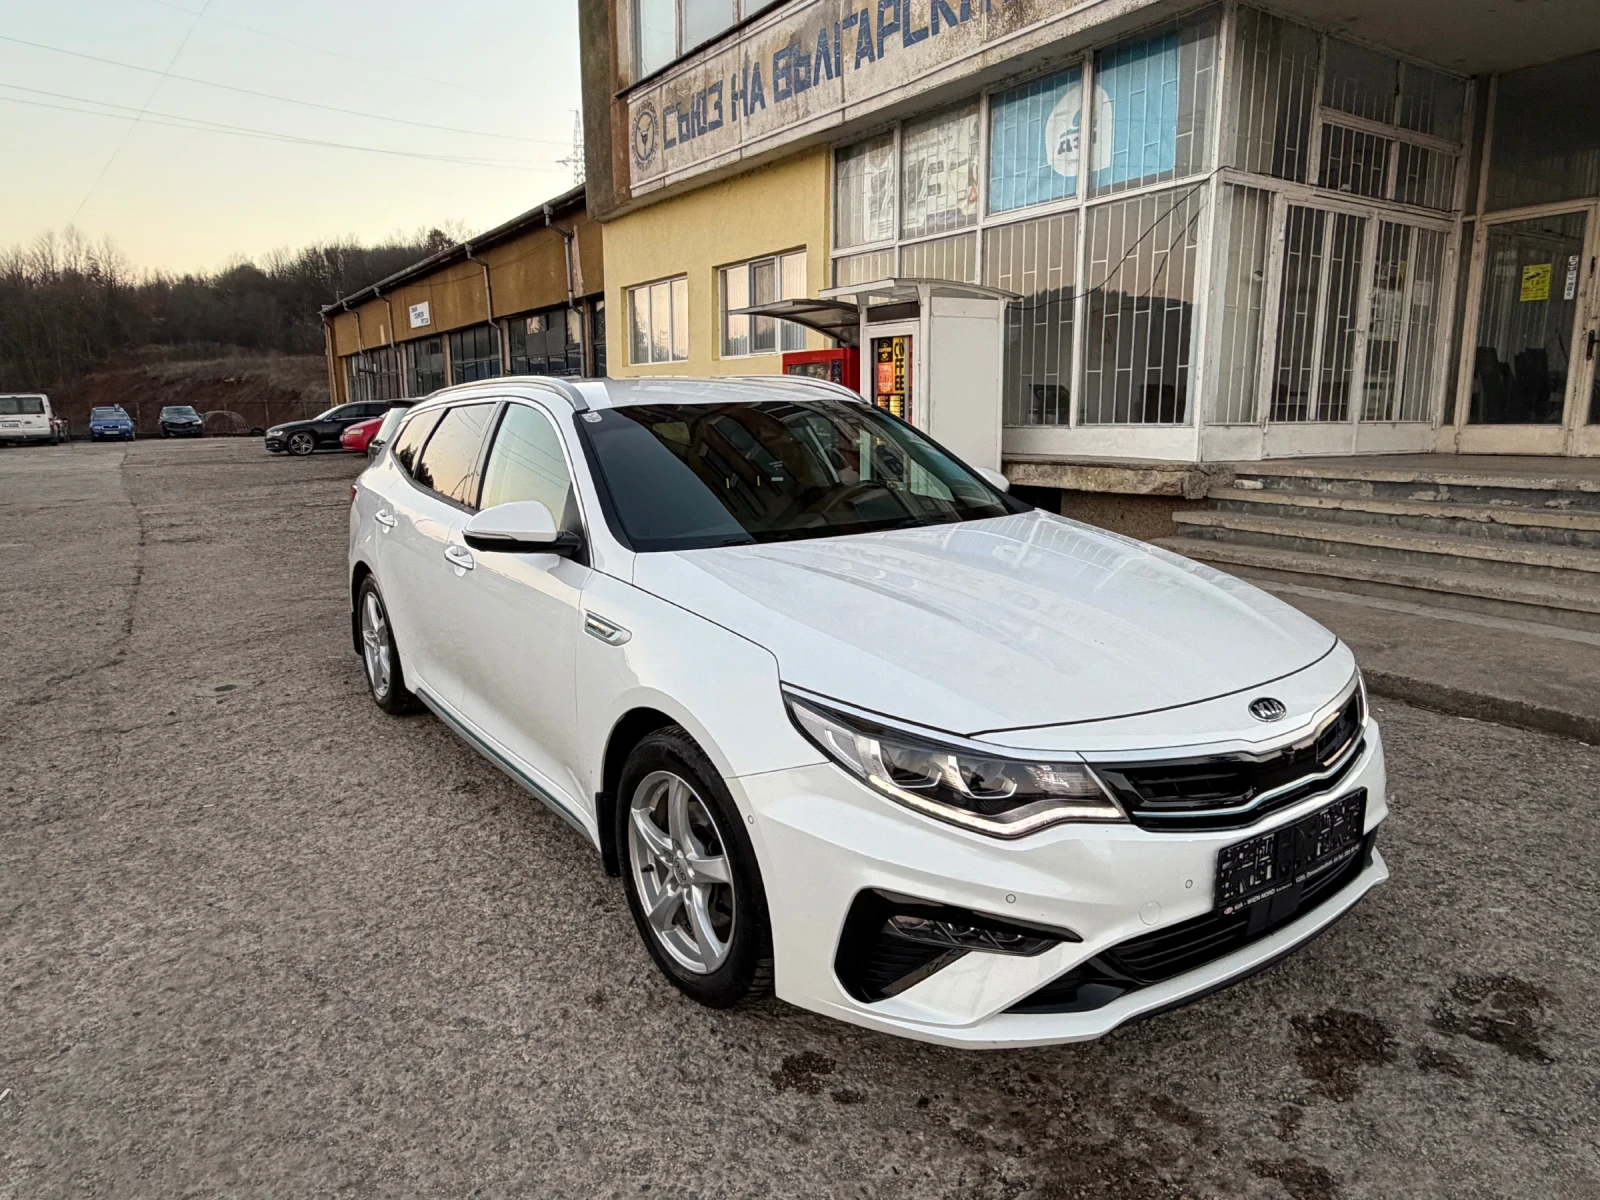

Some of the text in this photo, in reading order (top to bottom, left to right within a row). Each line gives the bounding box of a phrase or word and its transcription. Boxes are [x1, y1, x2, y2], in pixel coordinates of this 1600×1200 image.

[663, 79, 724, 150] СЪЮЗ
[731, 61, 766, 122] НА
[1252, 699, 1285, 718] KIA
